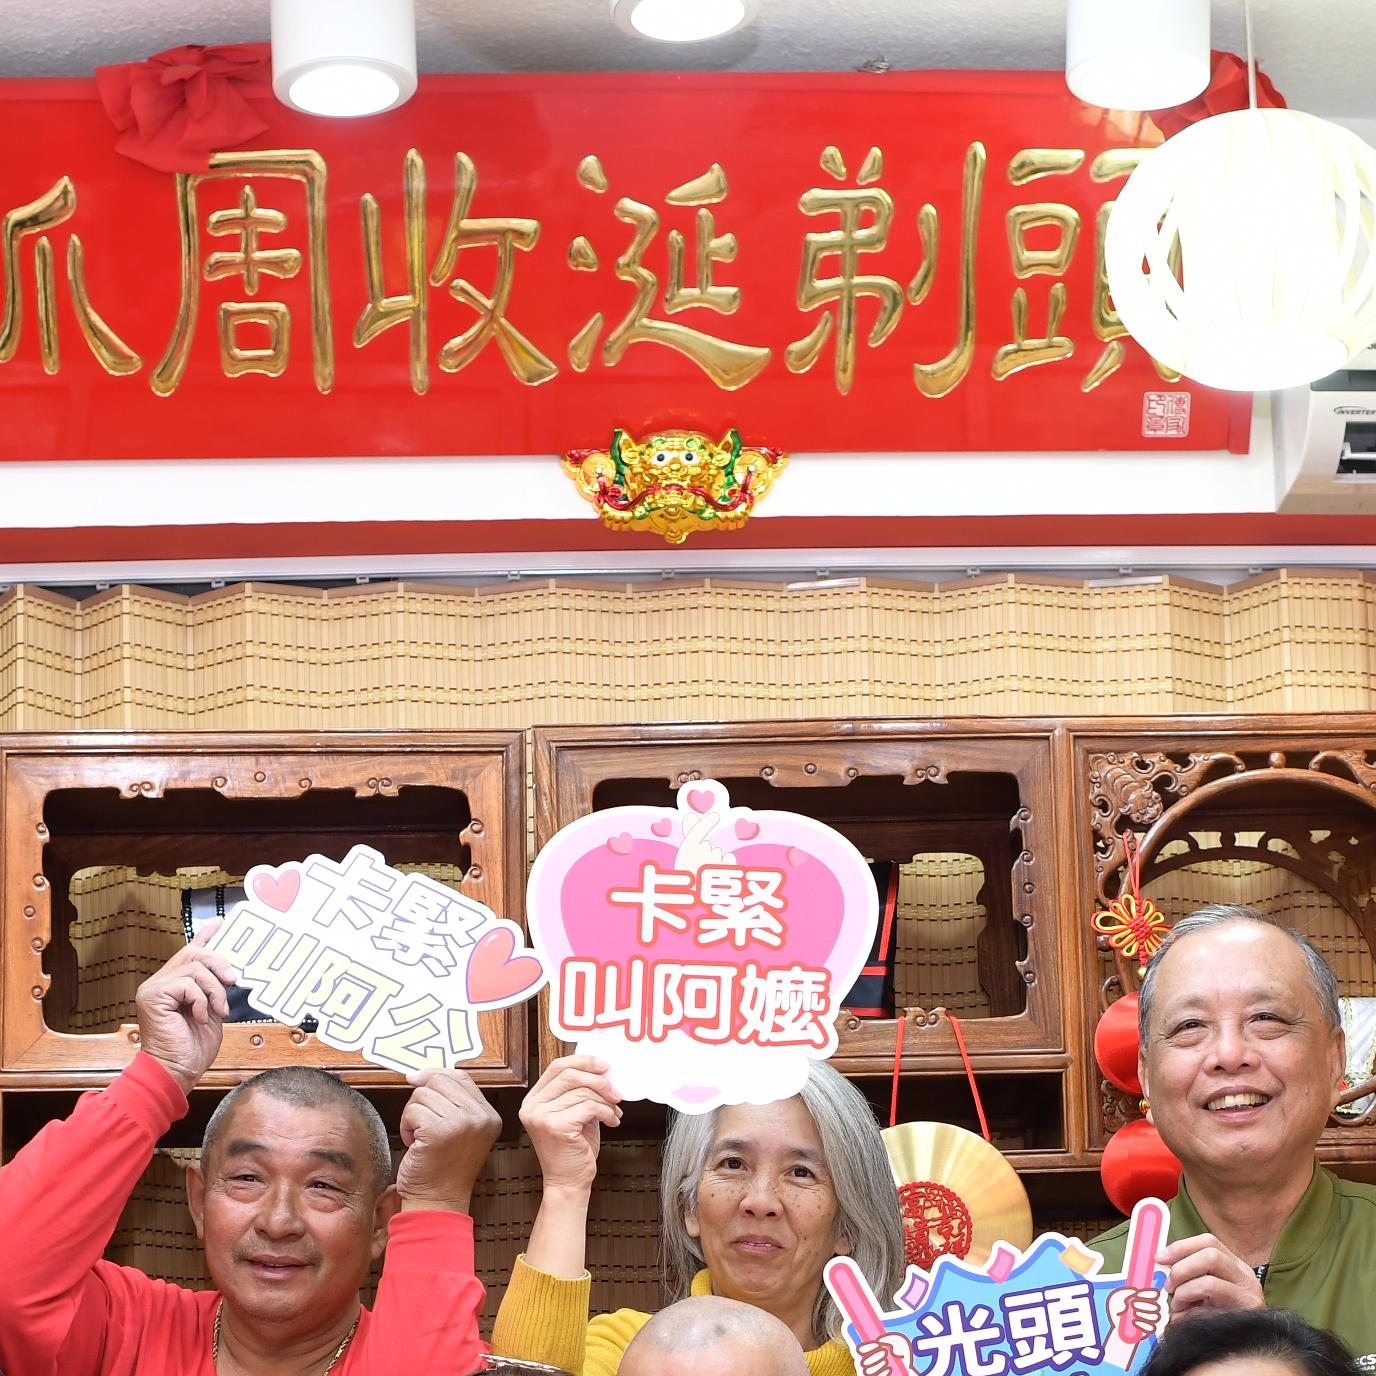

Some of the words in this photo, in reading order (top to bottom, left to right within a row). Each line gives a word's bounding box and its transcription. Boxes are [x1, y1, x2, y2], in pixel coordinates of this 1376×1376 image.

[307, 853, 487, 977] 卡緊
[609, 863, 785, 947] 卡緊
[213, 909, 474, 1070] 叫阿公
[562, 958, 827, 1046] 叫阿嬤
